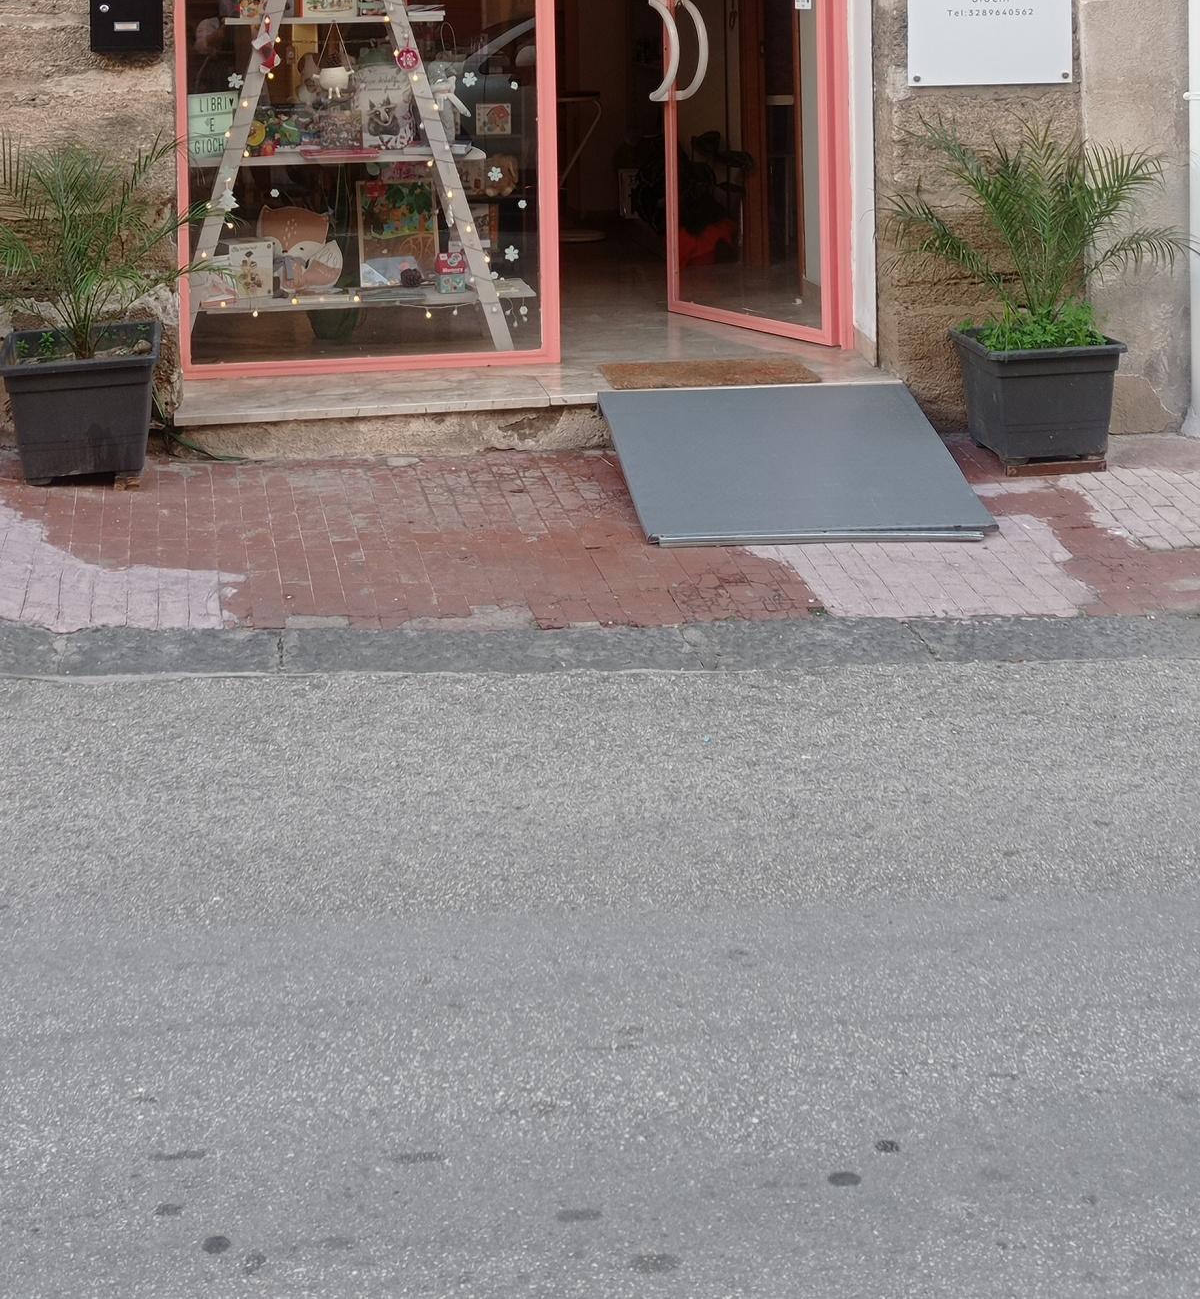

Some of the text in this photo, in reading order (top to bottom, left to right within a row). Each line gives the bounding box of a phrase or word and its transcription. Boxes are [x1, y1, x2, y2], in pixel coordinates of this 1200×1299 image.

[200, 96, 227, 112] LIBRI
[209, 117, 215, 132] E
[194, 137, 225, 154] GIOCH
